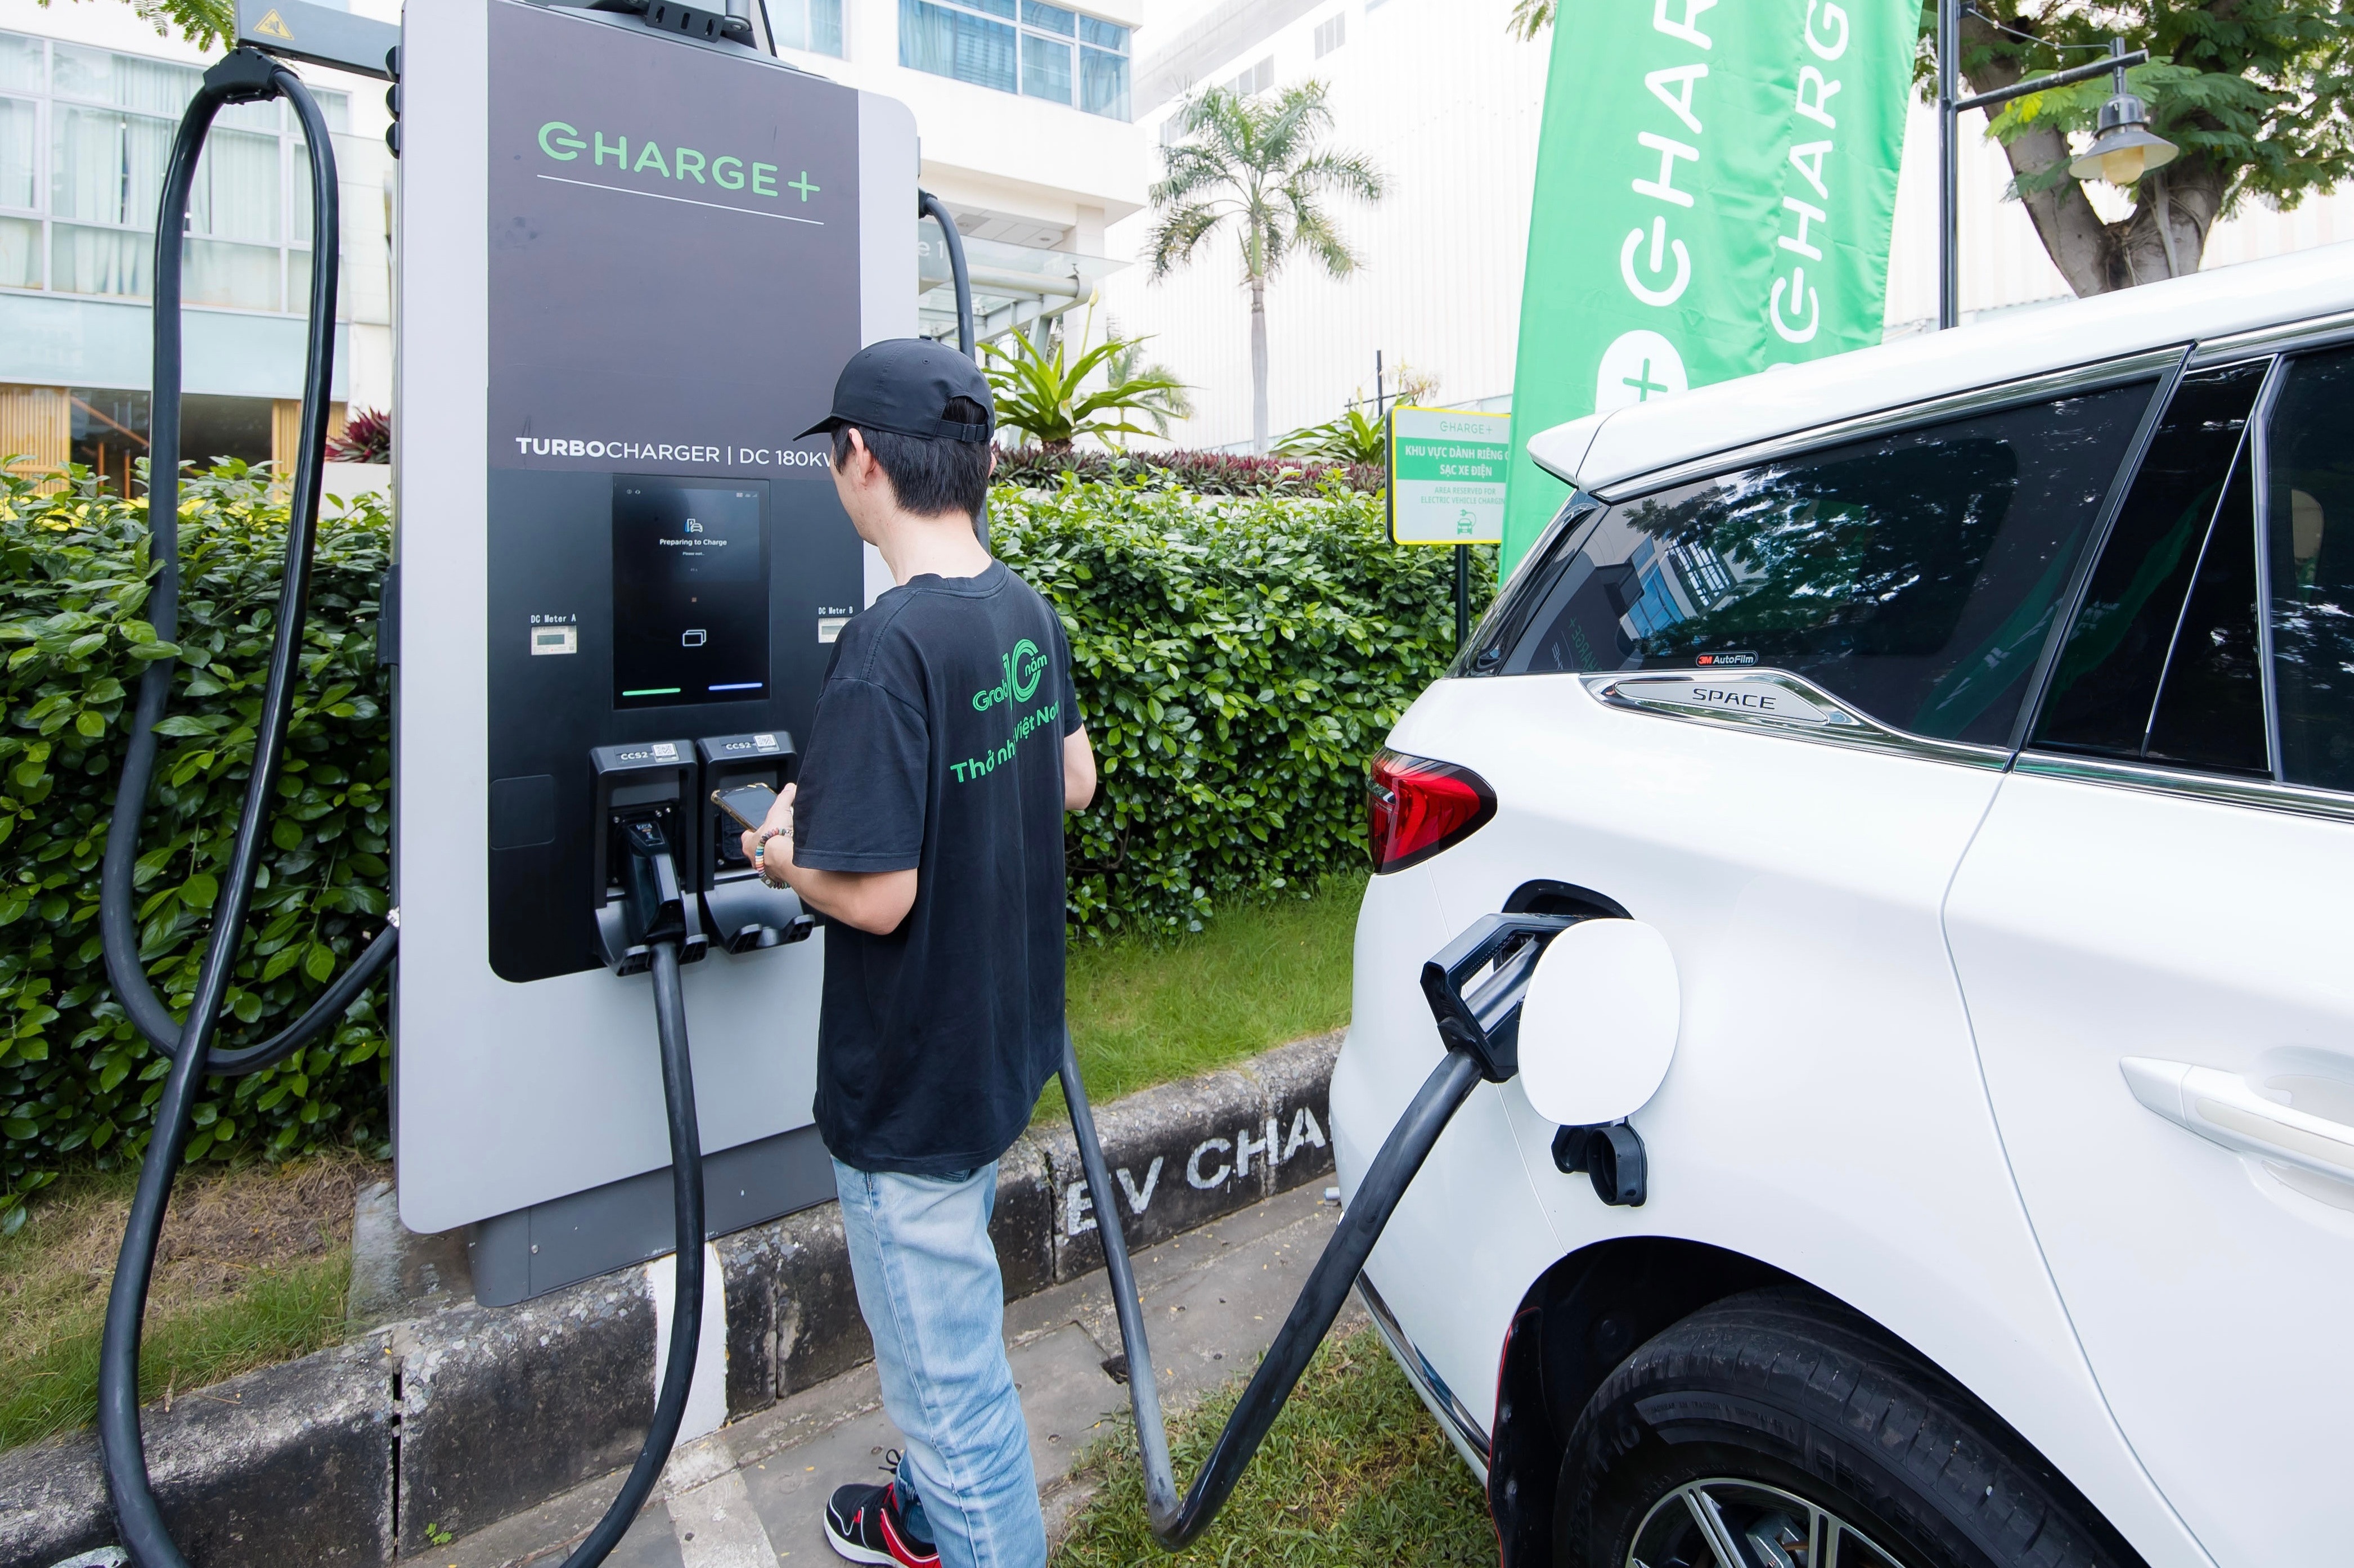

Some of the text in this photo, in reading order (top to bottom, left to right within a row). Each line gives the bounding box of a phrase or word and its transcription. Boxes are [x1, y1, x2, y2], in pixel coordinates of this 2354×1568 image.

[515, 437, 720, 463] TURBOCHARGER
[739, 448, 770, 466] DC
[1405, 446, 1426, 456] KHU
[1427, 446, 1447, 460] VỰC
[1449, 445, 1475, 459] DÀNH
[1477, 447, 1503, 460] RIÊNG
[1440, 464, 1492, 478] SẠC XE ĐIỆN
[1452, 496, 1477, 505] VEHICLE
[659, 538, 693, 547] Preparing
[703, 538, 727, 547] Charge
[818, 606, 826, 615] DC
[829, 606, 846, 614] Meter
[531, 614, 541, 623] DC
[571, 613, 577, 622] A
[1698, 654, 1754, 665] 3M AutoFilm
[972, 679, 1009, 712] Grab
[1025, 654, 1048, 677] năm
[1692, 688, 1777, 710] SPACE
[1014, 715, 1035, 743] Việt
[726, 742, 752, 751] CCS2
[620, 751, 649, 761] CCS2
[1066, 1106, 1333, 1236] EV CHA
